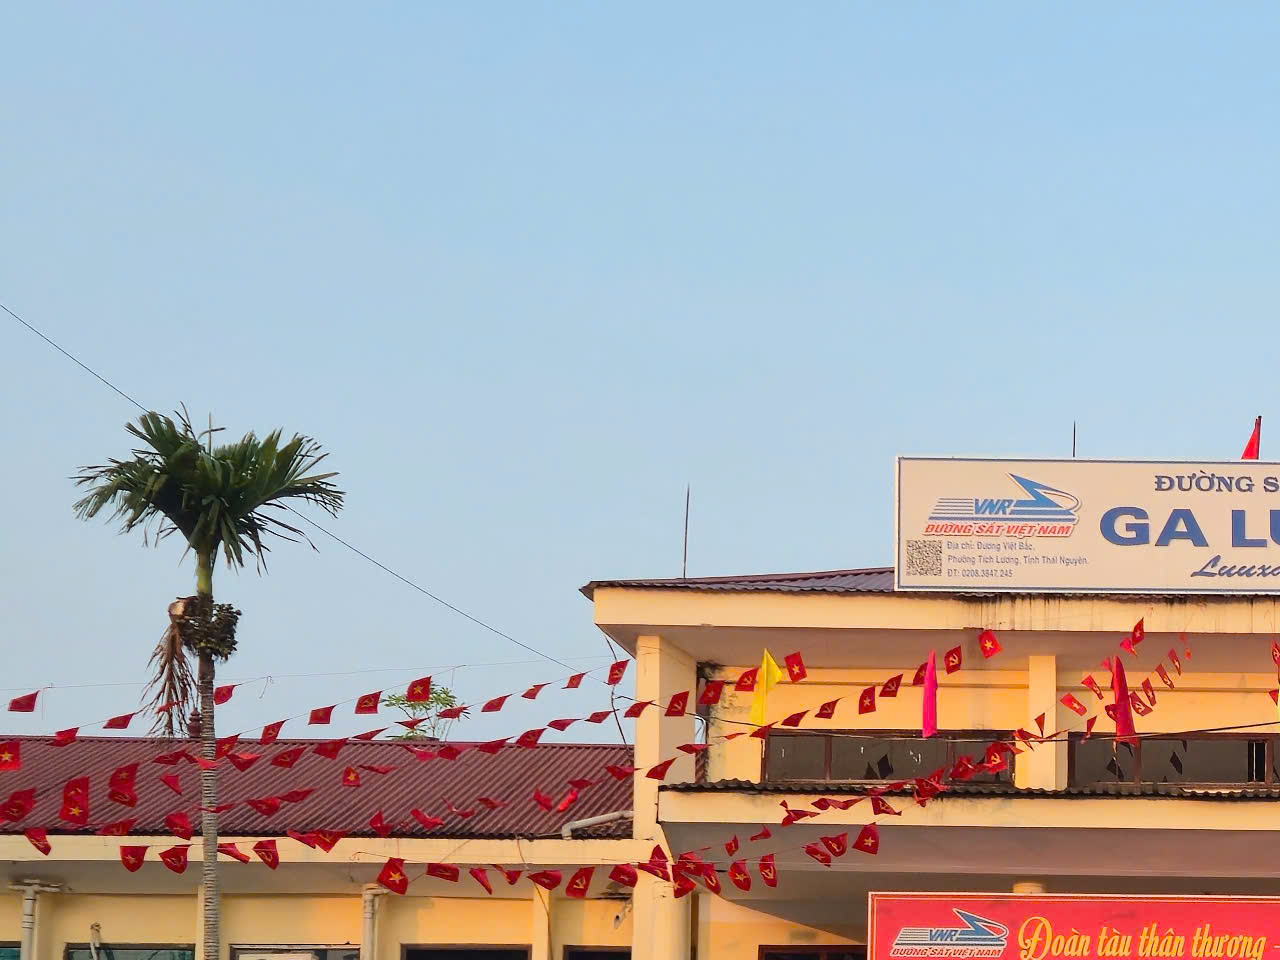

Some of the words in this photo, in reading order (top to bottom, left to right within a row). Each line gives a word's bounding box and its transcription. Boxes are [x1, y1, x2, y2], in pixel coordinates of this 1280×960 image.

[1154, 469, 1255, 493] ĐƯỜNG
[974, 499, 1014, 515] VNR
[1037, 525, 1072, 535] NAM
[1100, 507, 1208, 547] GA
[1097, 926, 1132, 957] tàu
[1138, 922, 1185, 958] thân
